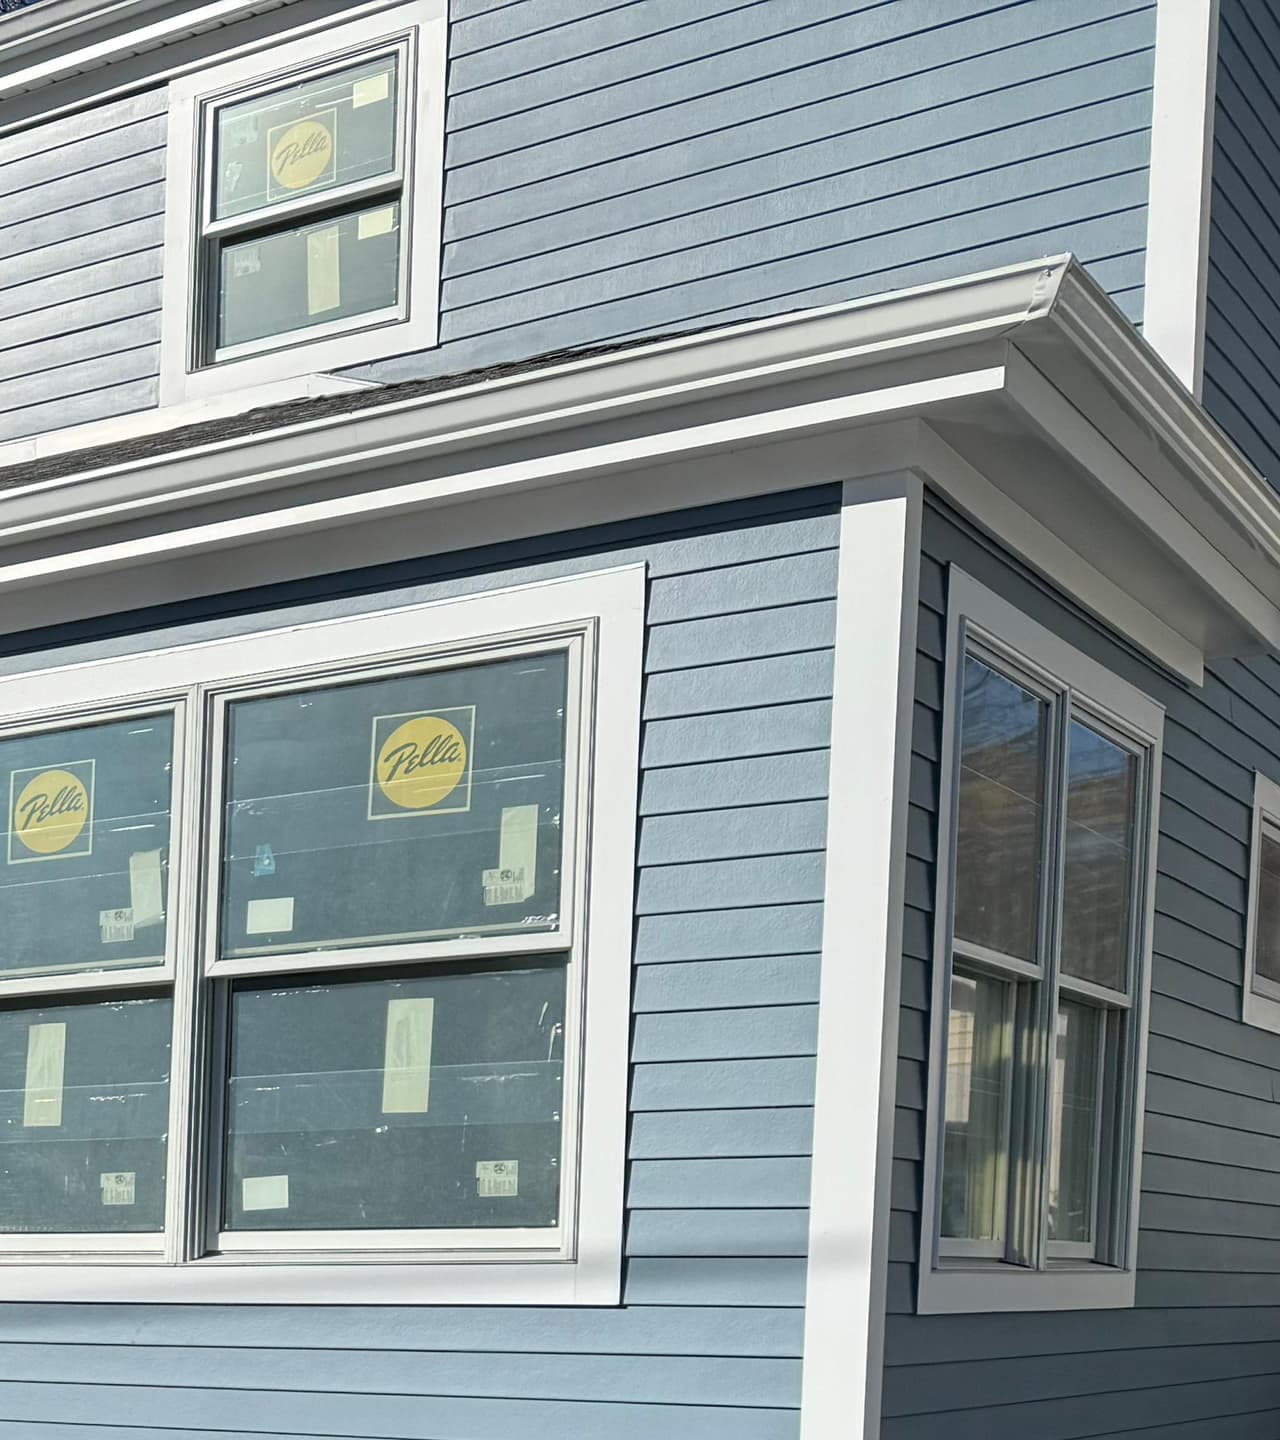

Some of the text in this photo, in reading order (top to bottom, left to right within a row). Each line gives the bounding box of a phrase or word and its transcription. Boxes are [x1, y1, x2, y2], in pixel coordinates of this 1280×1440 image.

[276, 131, 328, 176] Pella
[383, 734, 460, 782] Pella
[20, 785, 82, 831] Pella
